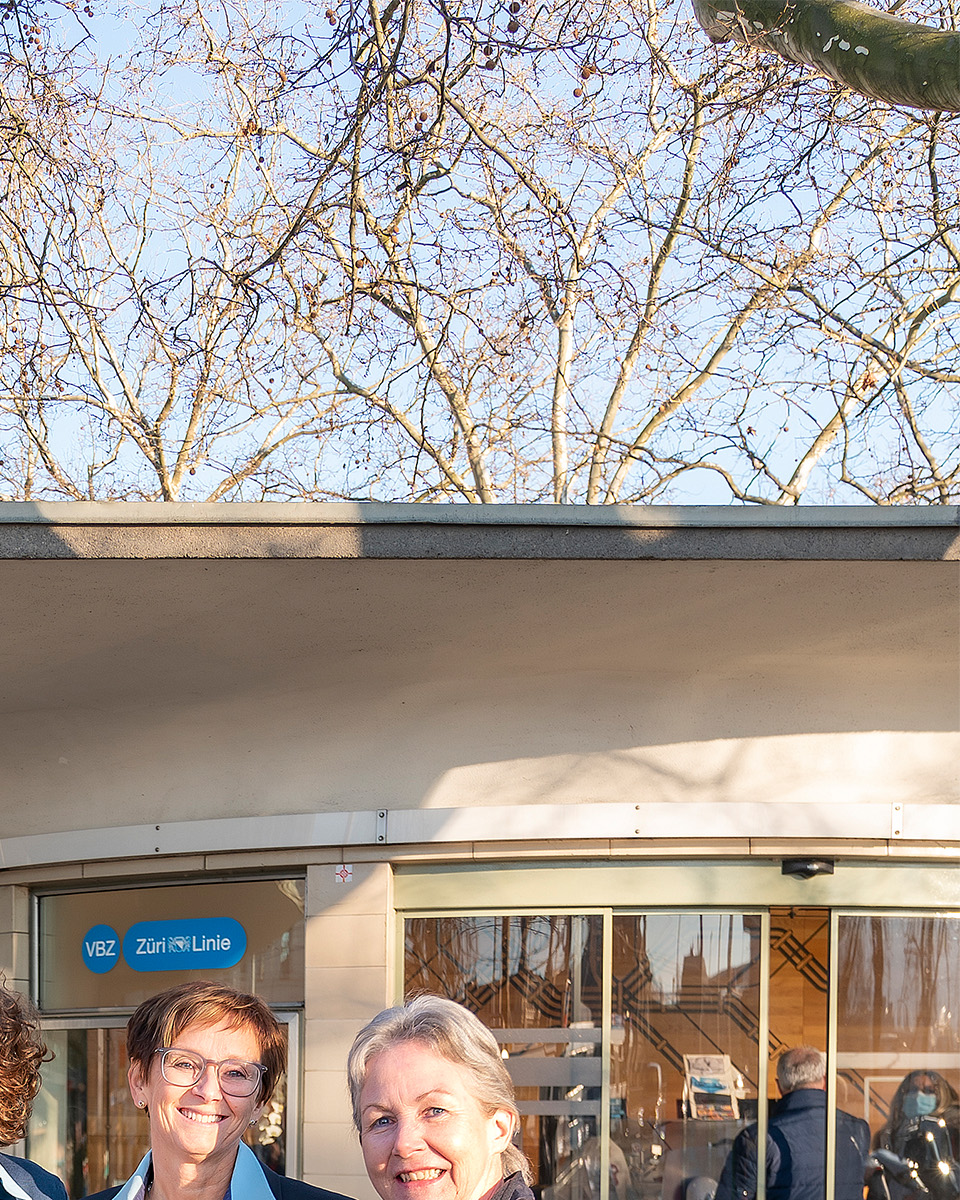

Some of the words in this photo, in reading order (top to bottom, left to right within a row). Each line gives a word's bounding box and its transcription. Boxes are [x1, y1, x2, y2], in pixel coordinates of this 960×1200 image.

[85, 940, 116, 958] VBZ
[135, 937, 166, 955] Züri
[192, 934, 231, 952] Linie
